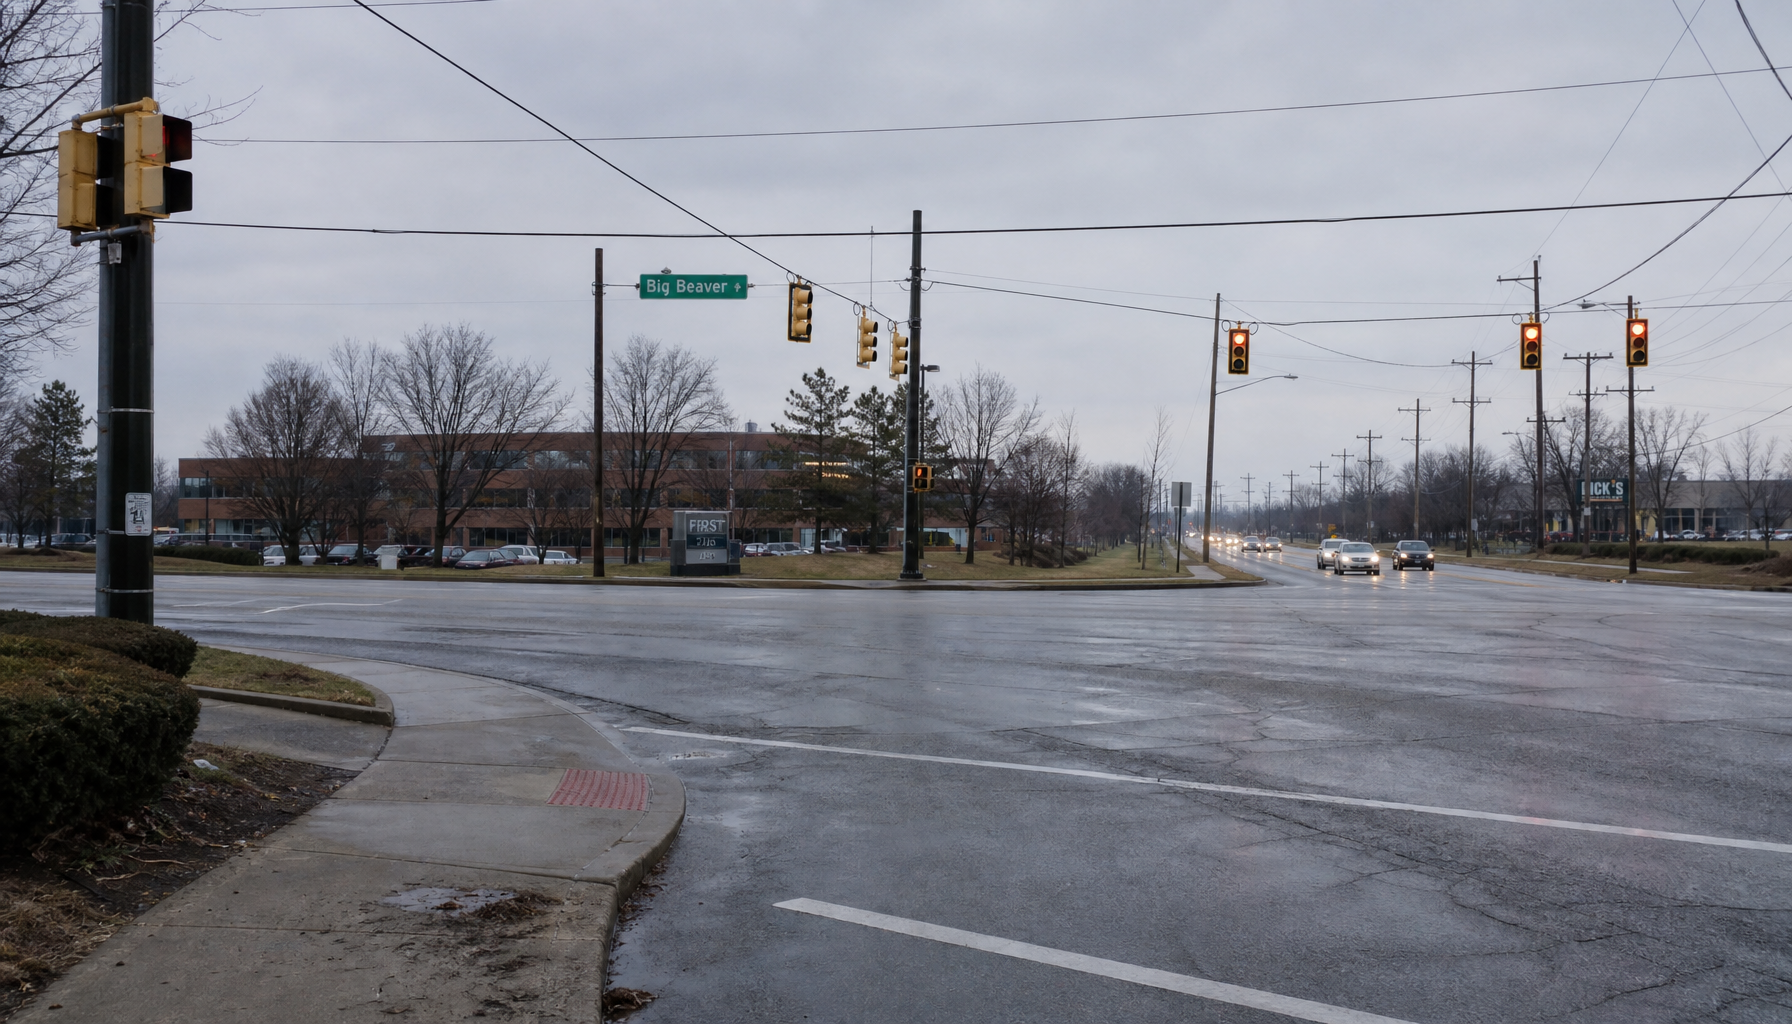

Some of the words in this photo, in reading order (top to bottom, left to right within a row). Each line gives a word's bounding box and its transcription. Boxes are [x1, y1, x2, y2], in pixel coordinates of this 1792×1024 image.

[646, 279, 670, 296] Big
[676, 279, 728, 293] Beaver
[689, 519, 726, 532] FIRST
